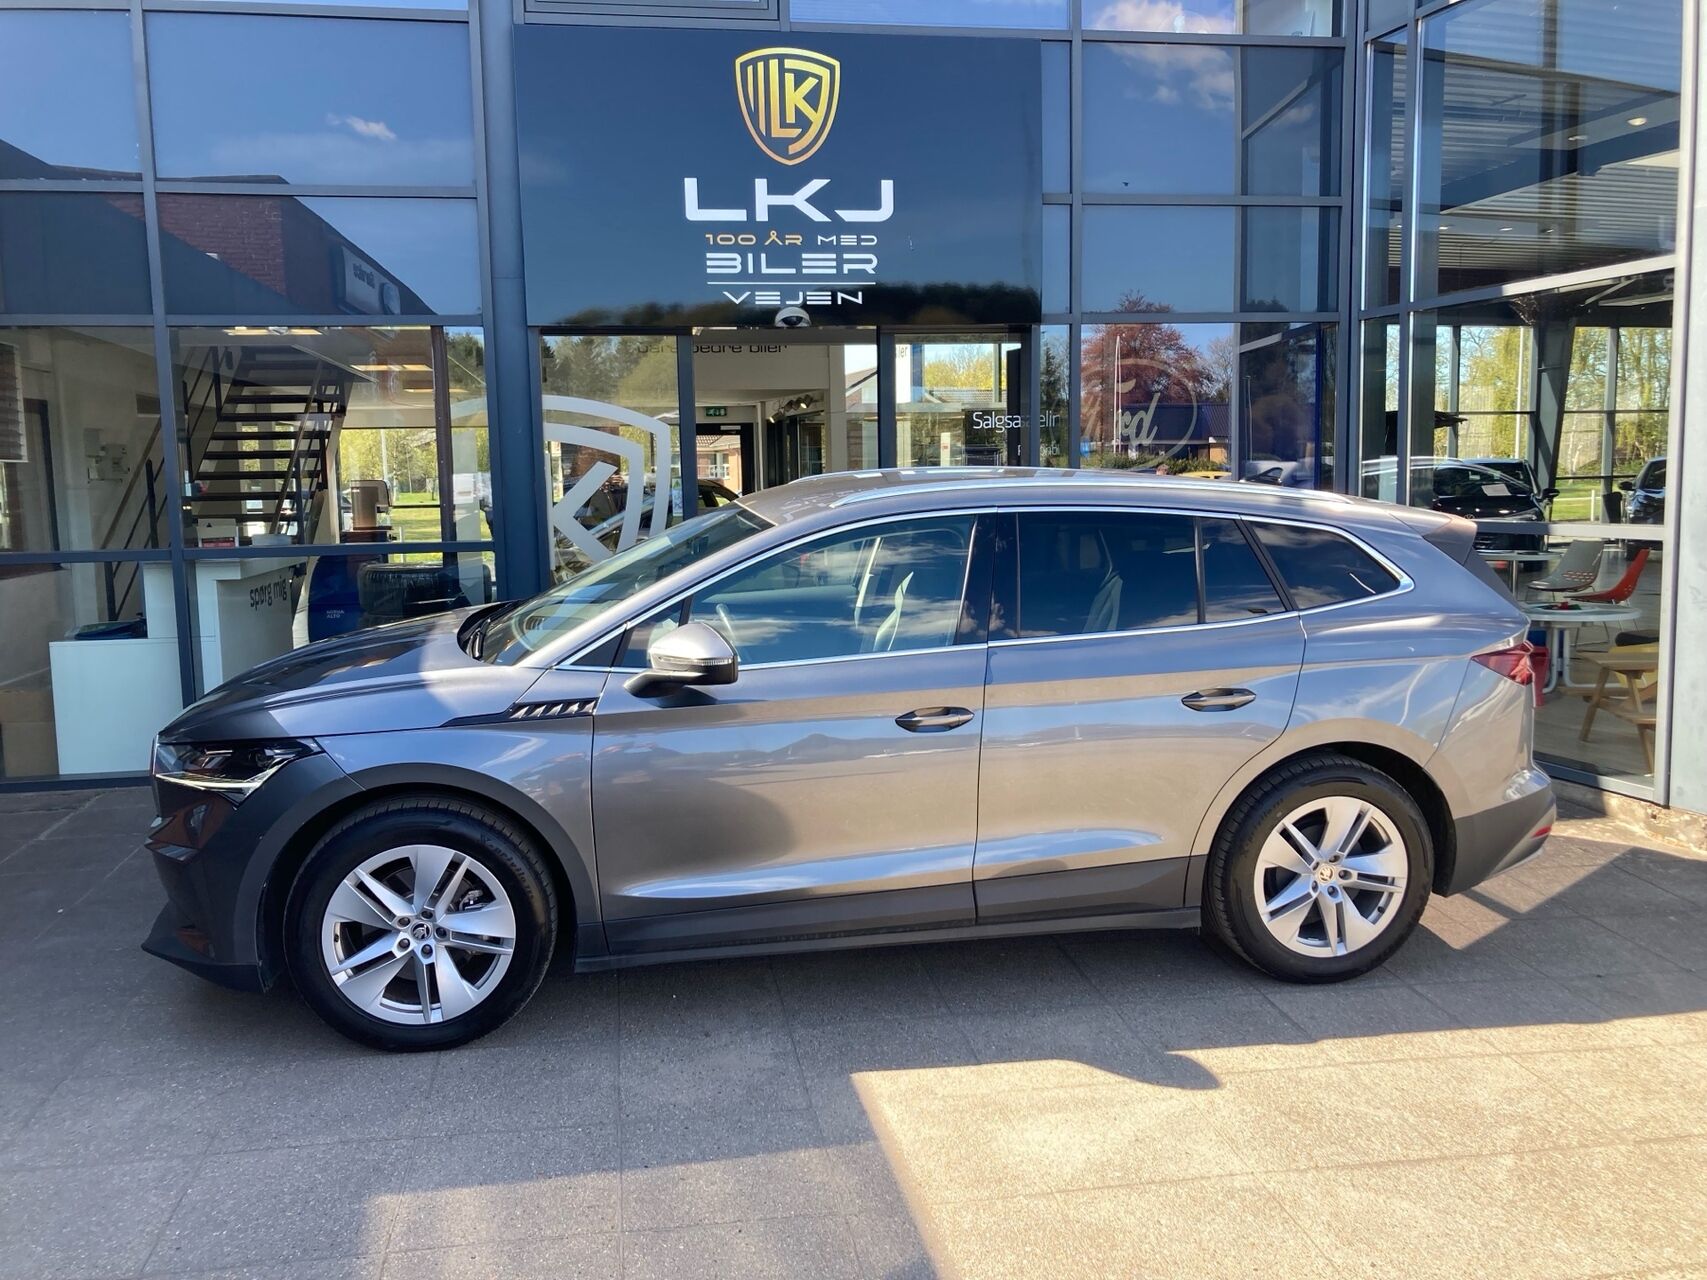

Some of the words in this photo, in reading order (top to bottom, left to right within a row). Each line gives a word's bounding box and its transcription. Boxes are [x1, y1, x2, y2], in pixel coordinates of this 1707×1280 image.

[684, 177, 894, 222] LKJ
[705, 233, 757, 245] 100
[764, 230, 803, 246] ÅR
[817, 235, 878, 246] MED
[706, 252, 878, 274] BILER
[723, 291, 863, 305] VEJEN
